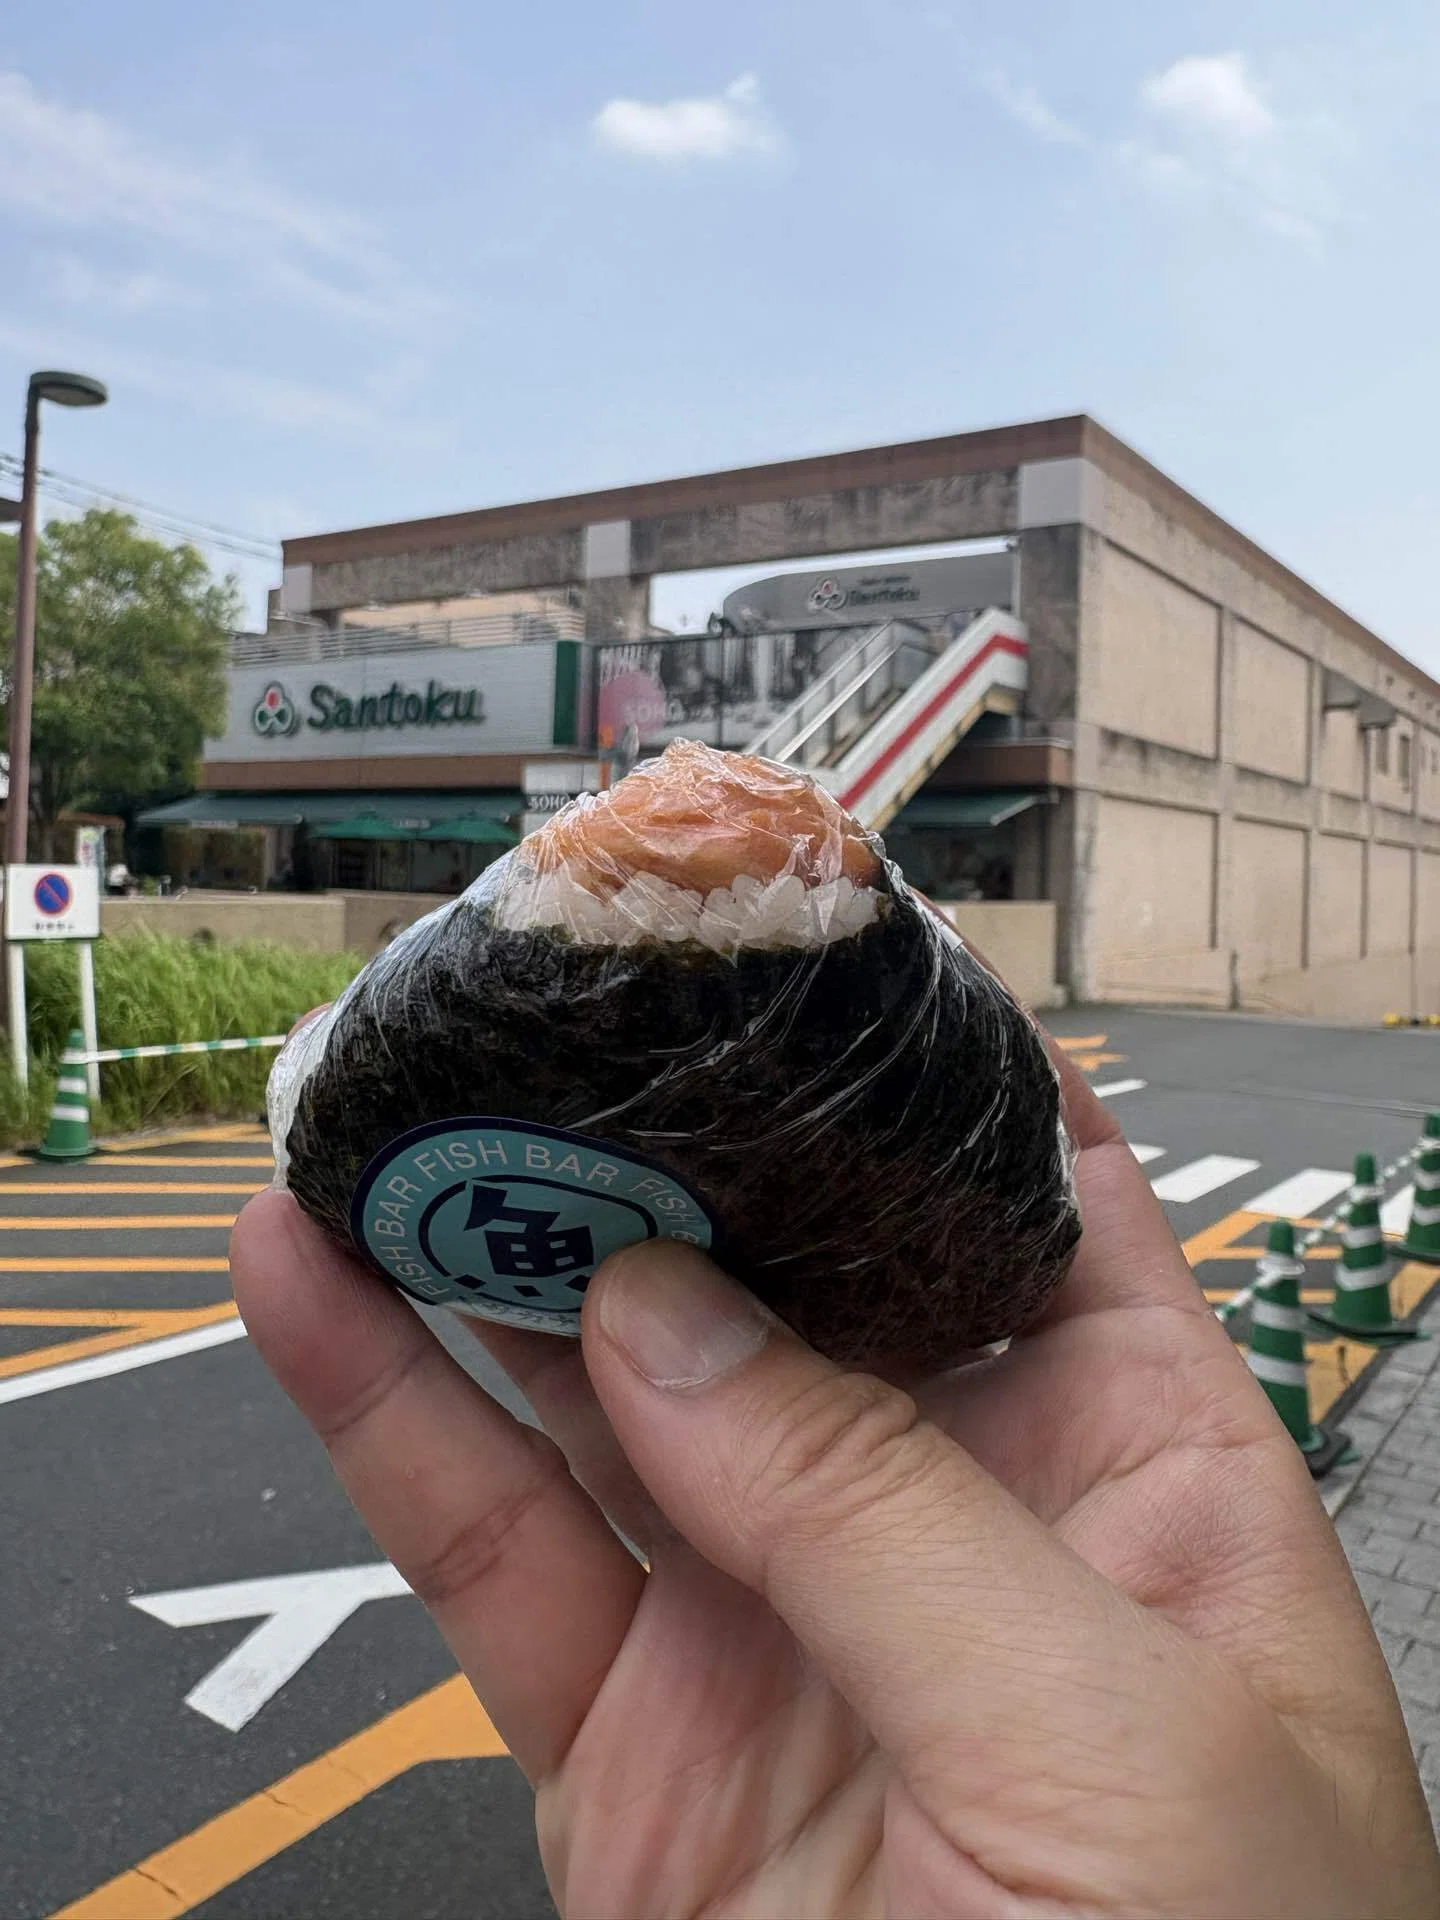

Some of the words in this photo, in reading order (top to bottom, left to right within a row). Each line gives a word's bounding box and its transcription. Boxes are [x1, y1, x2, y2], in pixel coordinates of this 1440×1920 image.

[307, 679, 483, 730] Santoku
[413, 1139, 508, 1182] FISH
[525, 1143, 620, 1187] BAR
[374, 1175, 423, 1238] BAR
[628, 1178, 697, 1223] FISH
[380, 1246, 450, 1296] FISH
